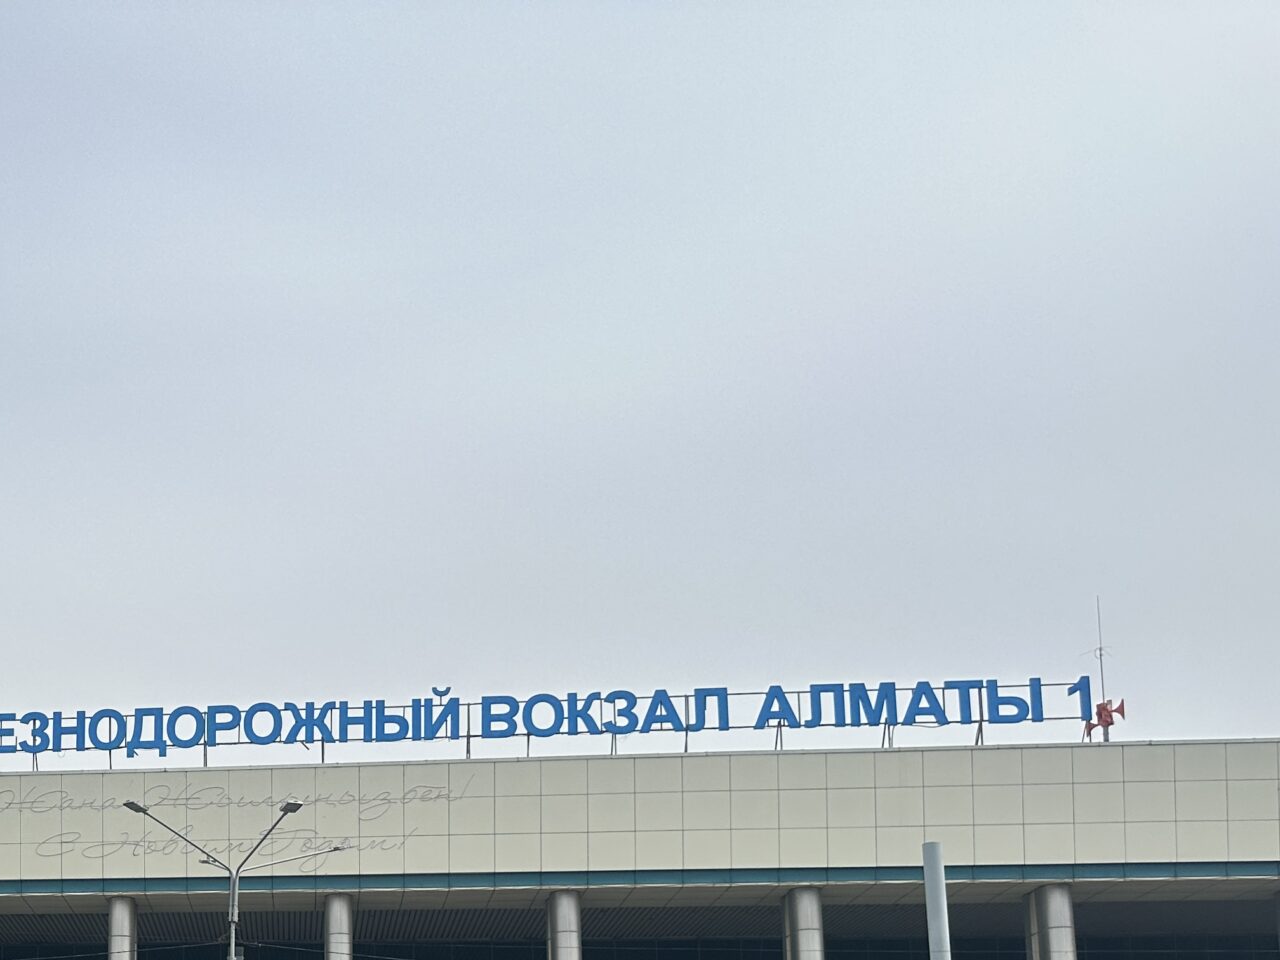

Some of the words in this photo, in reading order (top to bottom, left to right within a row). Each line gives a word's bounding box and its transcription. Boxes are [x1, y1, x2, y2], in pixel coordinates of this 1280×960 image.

[480, 687, 730, 739] ВОКЗАЛ
[754, 680, 1044, 730] АЛМАТЫ
[1068, 676, 1093, 722] 1
